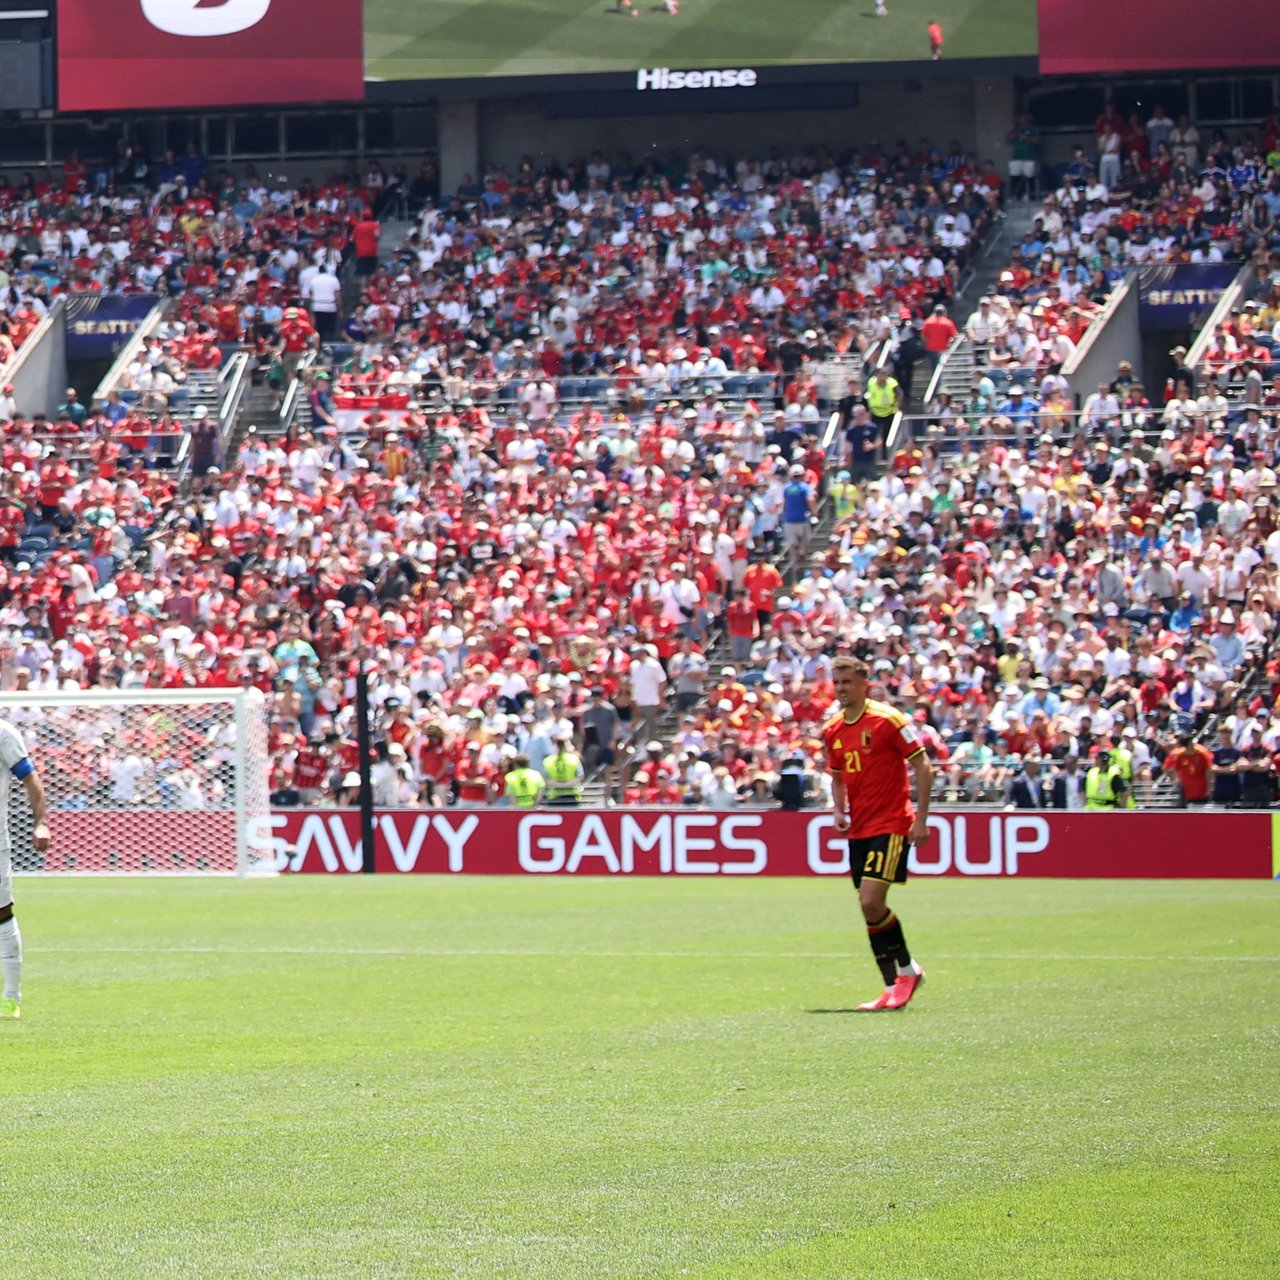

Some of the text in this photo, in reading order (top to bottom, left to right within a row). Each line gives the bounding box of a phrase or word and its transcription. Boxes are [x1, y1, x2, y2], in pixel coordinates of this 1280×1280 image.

[636, 66, 757, 91] Hisense
[844, 750, 862, 773] 21
[246, 814, 1050, 876] SAVVY GAMES GOUP
[863, 850, 883, 873] 21
